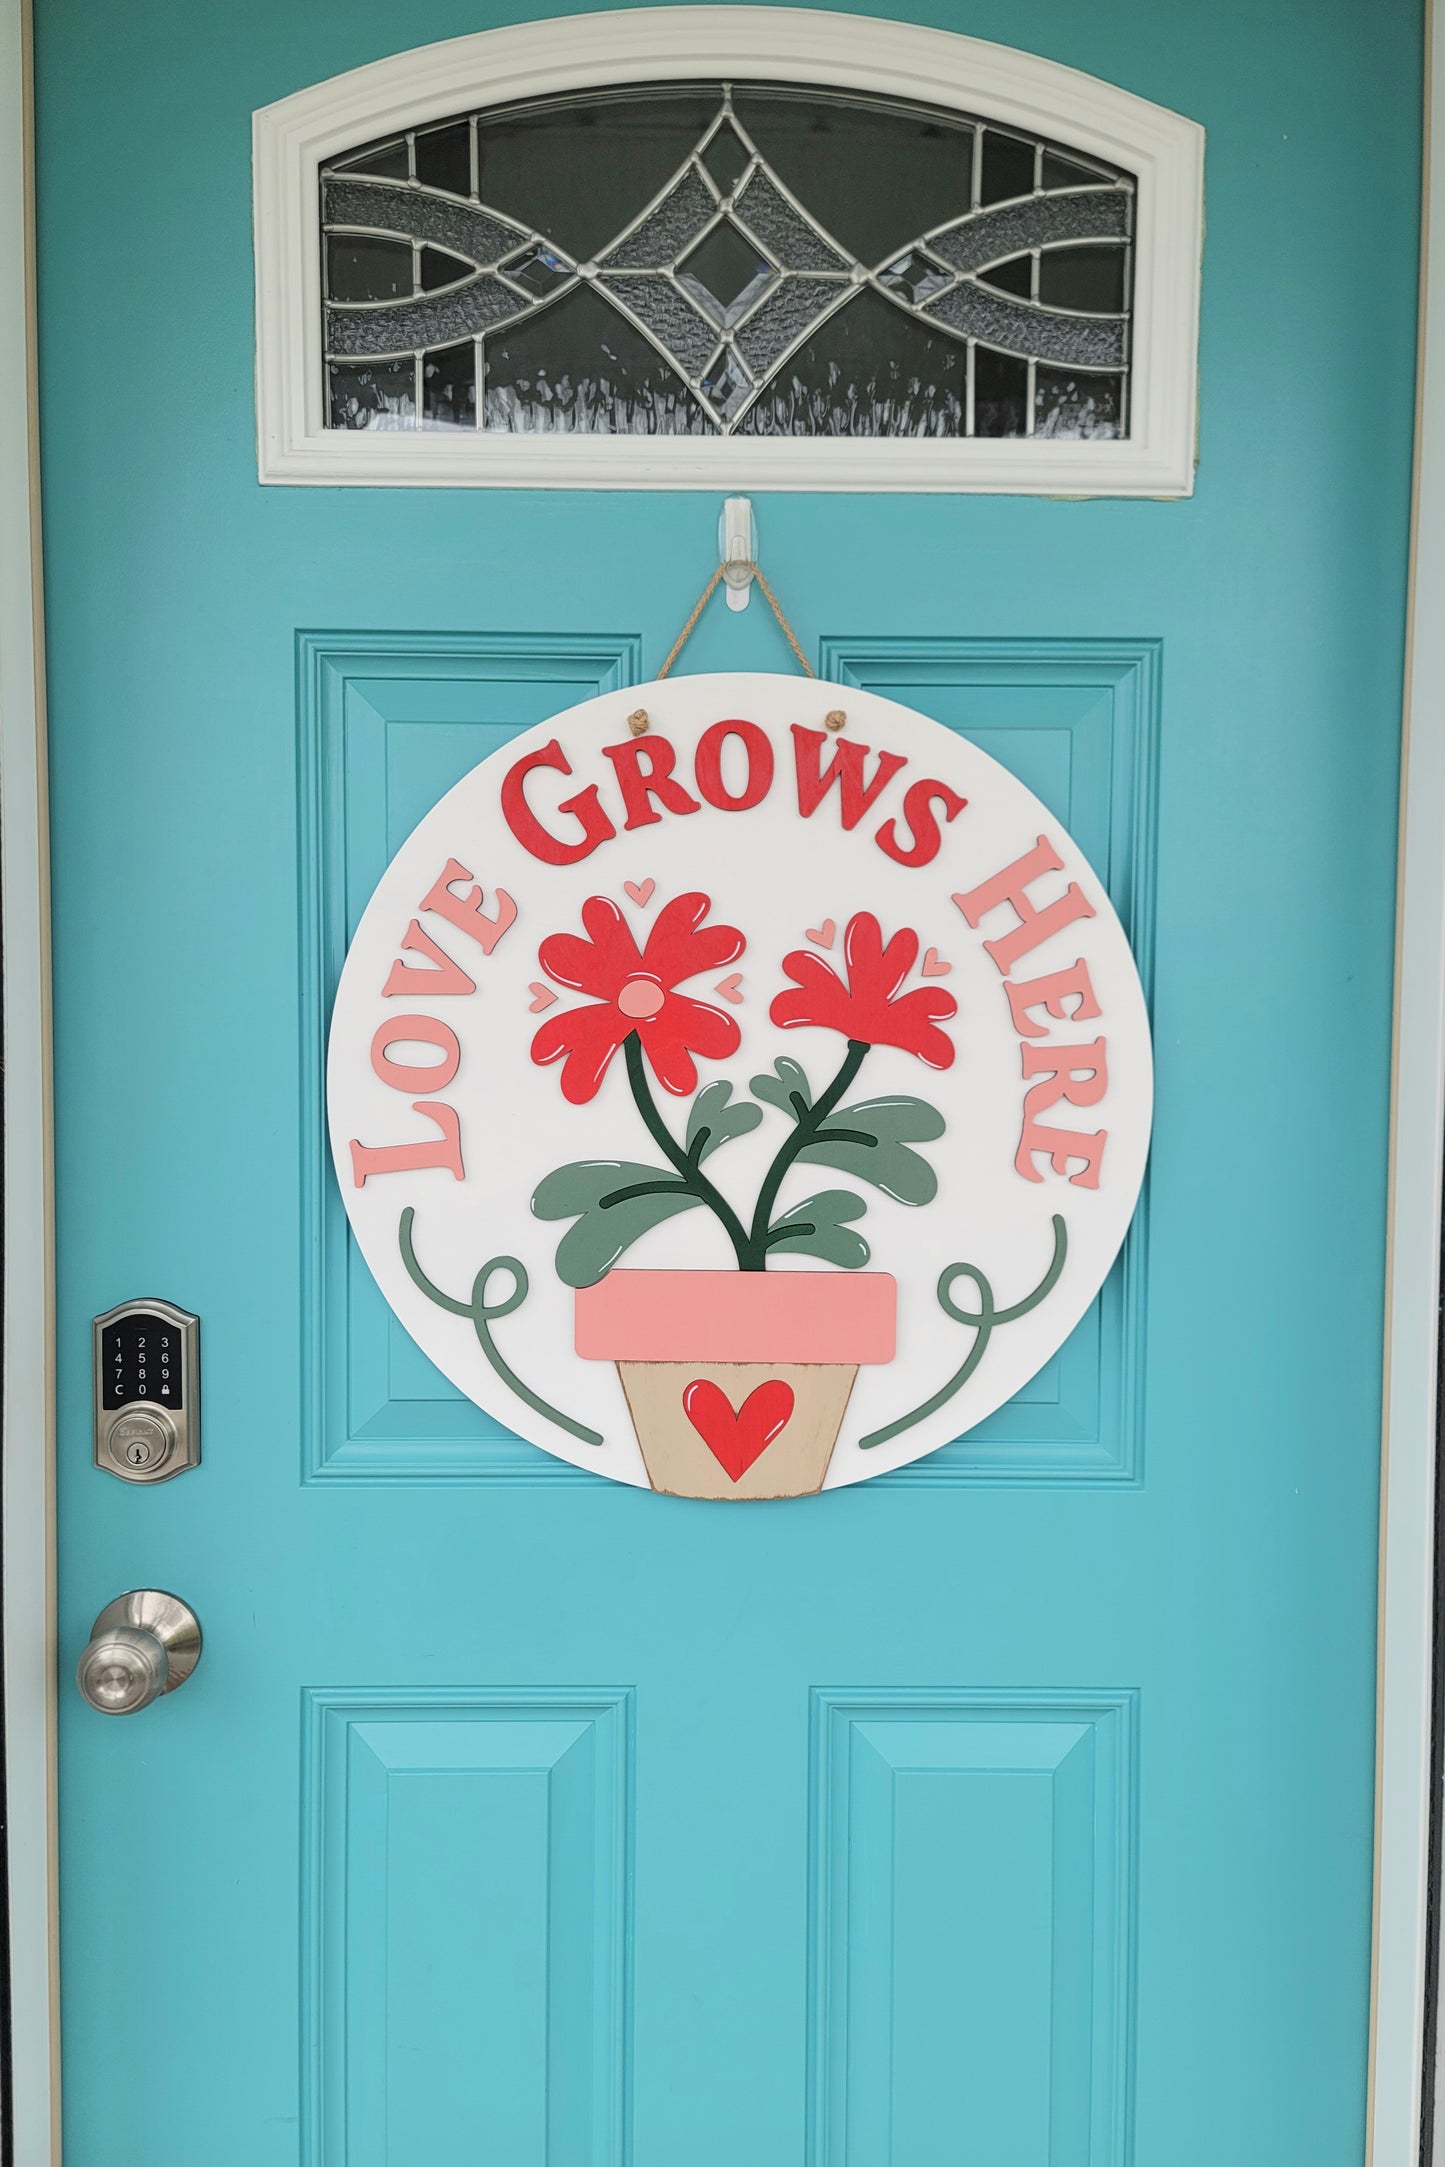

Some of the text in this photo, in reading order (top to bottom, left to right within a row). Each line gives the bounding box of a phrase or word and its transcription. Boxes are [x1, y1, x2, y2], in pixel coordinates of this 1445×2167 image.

[350, 718, 1107, 1190] LOVE GROWS HERE
[115, 1337, 169, 1348] 1 2 3
[114, 1353, 169, 1364] 4 5 6
[115, 1368, 170, 1379] 7 8 9
[114, 1384, 147, 1395] C 0
